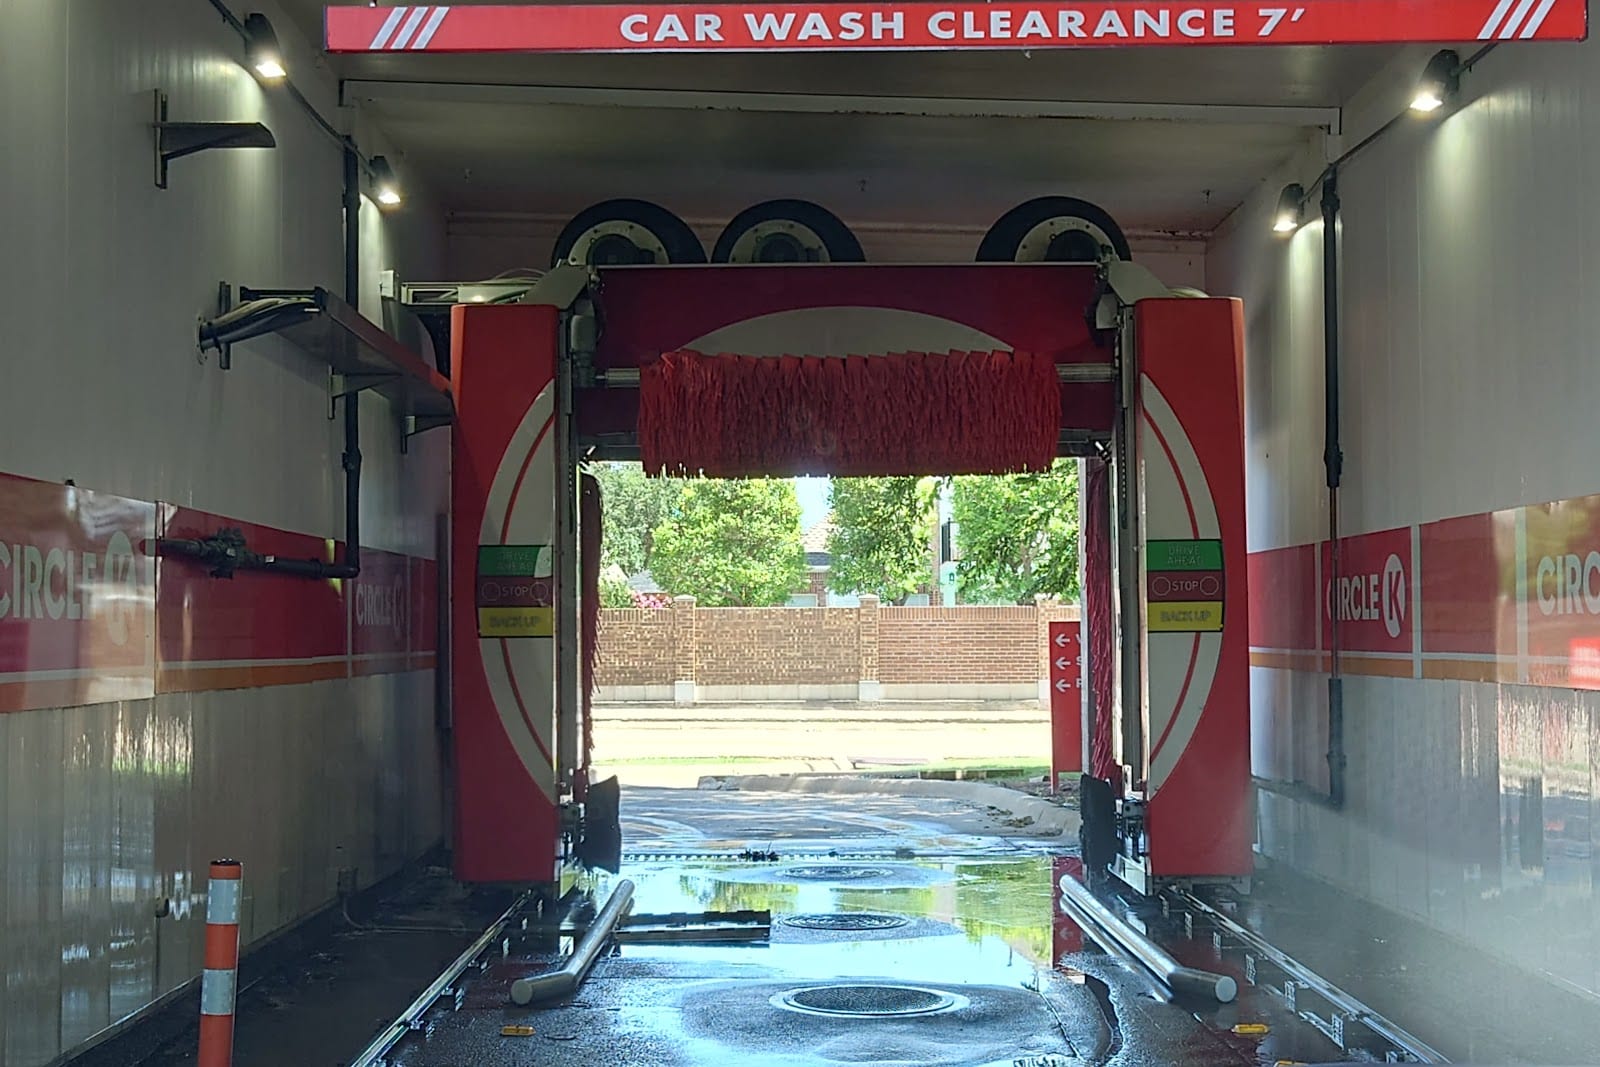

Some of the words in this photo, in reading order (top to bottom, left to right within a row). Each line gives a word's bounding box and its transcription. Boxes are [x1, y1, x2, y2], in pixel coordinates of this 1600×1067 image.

[619, 13, 724, 42] CAR
[743, 12, 905, 41] WASH
[926, 8, 1236, 40] CLEARANCE
[502, 585, 529, 597] STOP
[1172, 580, 1199, 592] STOP
[1382, 553, 1405, 638] K
